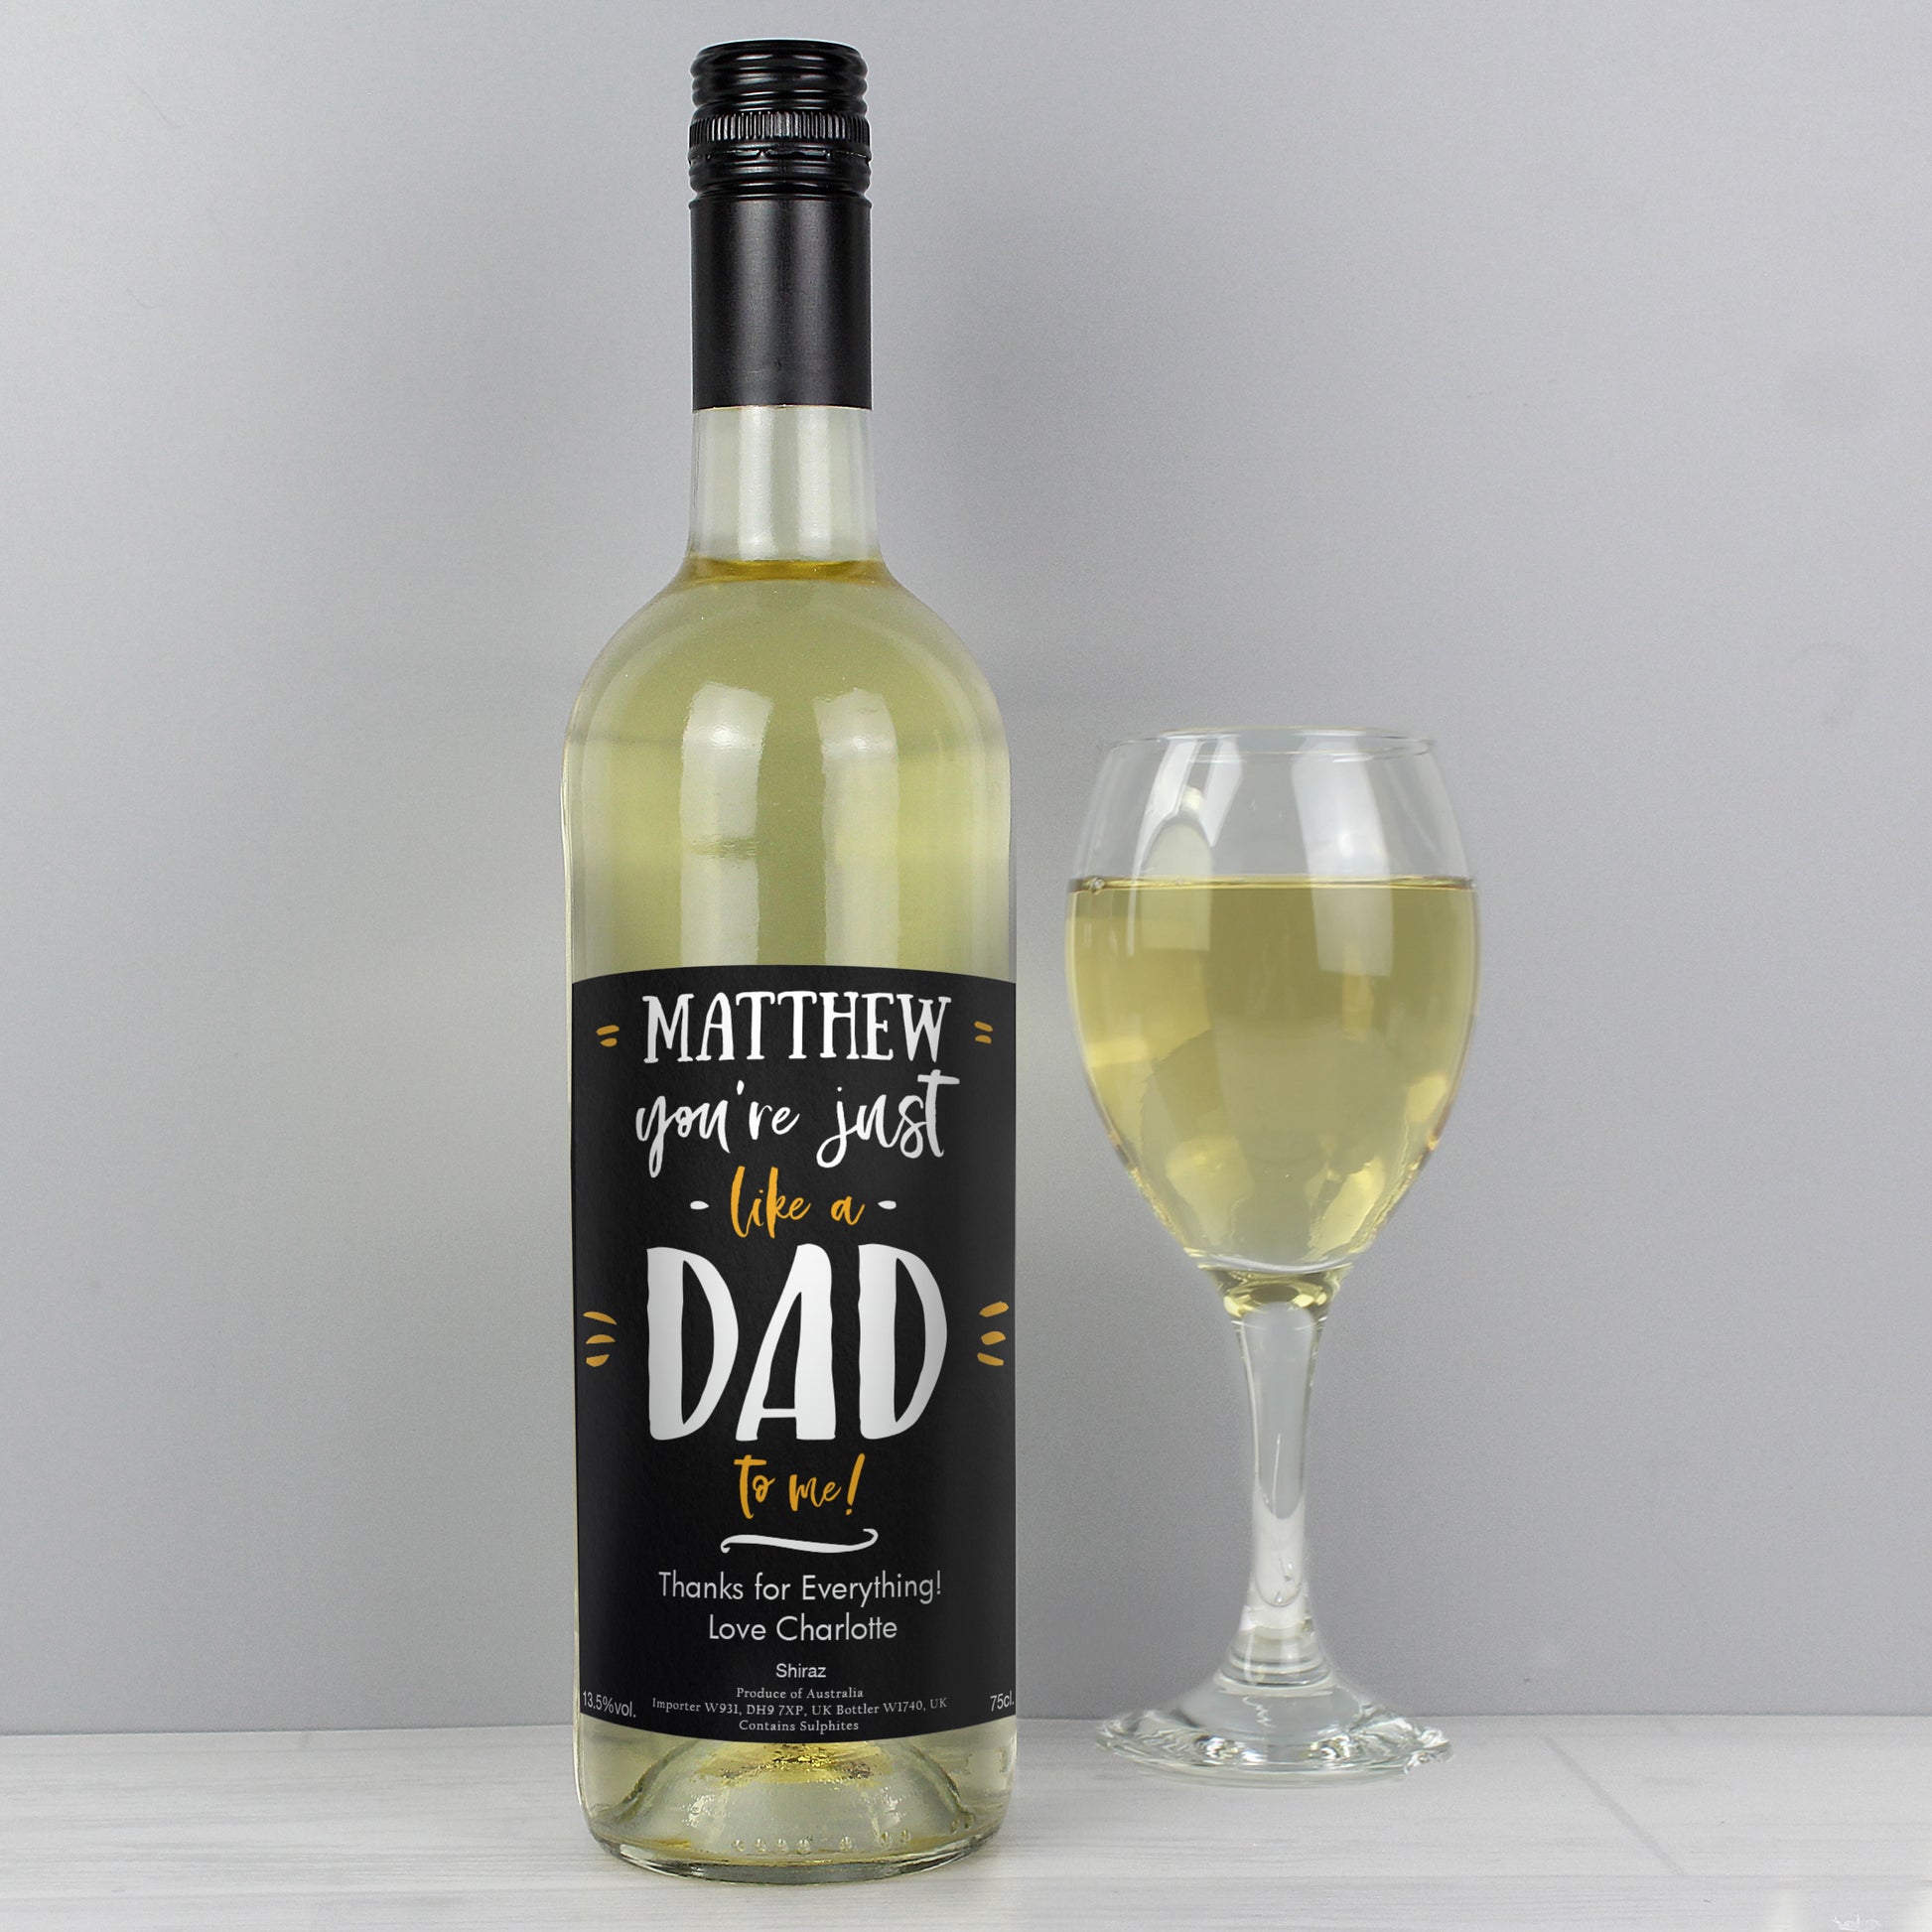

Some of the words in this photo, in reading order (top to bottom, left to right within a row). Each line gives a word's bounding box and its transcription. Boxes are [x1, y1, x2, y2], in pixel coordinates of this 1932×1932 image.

[642, 991, 951, 1063] MATTHEW
[636, 1080, 800, 1178] you're
[816, 1069, 960, 1168] just
[731, 1166, 811, 1238] like
[831, 1196, 865, 1225] a
[647, 1243, 947, 1442] DAD
[734, 1454, 775, 1519] to
[789, 1453, 865, 1515] me!
[659, 1570, 743, 1599] Thanks
[755, 1573, 790, 1599] for
[803, 1571, 940, 1607] Everything!
[710, 1614, 765, 1640] Love
[776, 1613, 897, 1641] Charlotte
[776, 1663, 826, 1678] Shiraz
[582, 1690, 636, 1718] 13.5%vol.
[737, 1688, 785, 1698] Produce
[790, 1688, 802, 1698] of
[807, 1687, 863, 1698] Australia
[990, 1691, 1014, 1712] 75cl.
[653, 1698, 700, 1713] Importer
[705, 1703, 742, 1716] W931,
[747, 1705, 774, 1715] DH9
[778, 1706, 806, 1717] 7XP,
[812, 1706, 831, 1715] UK
[837, 1704, 879, 1715] Bottler
[884, 1701, 925, 1712] W1740,
[930, 1698, 946, 1708] UK
[740, 1721, 795, 1730] Contains
[800, 1721, 858, 1734] Sulphites
